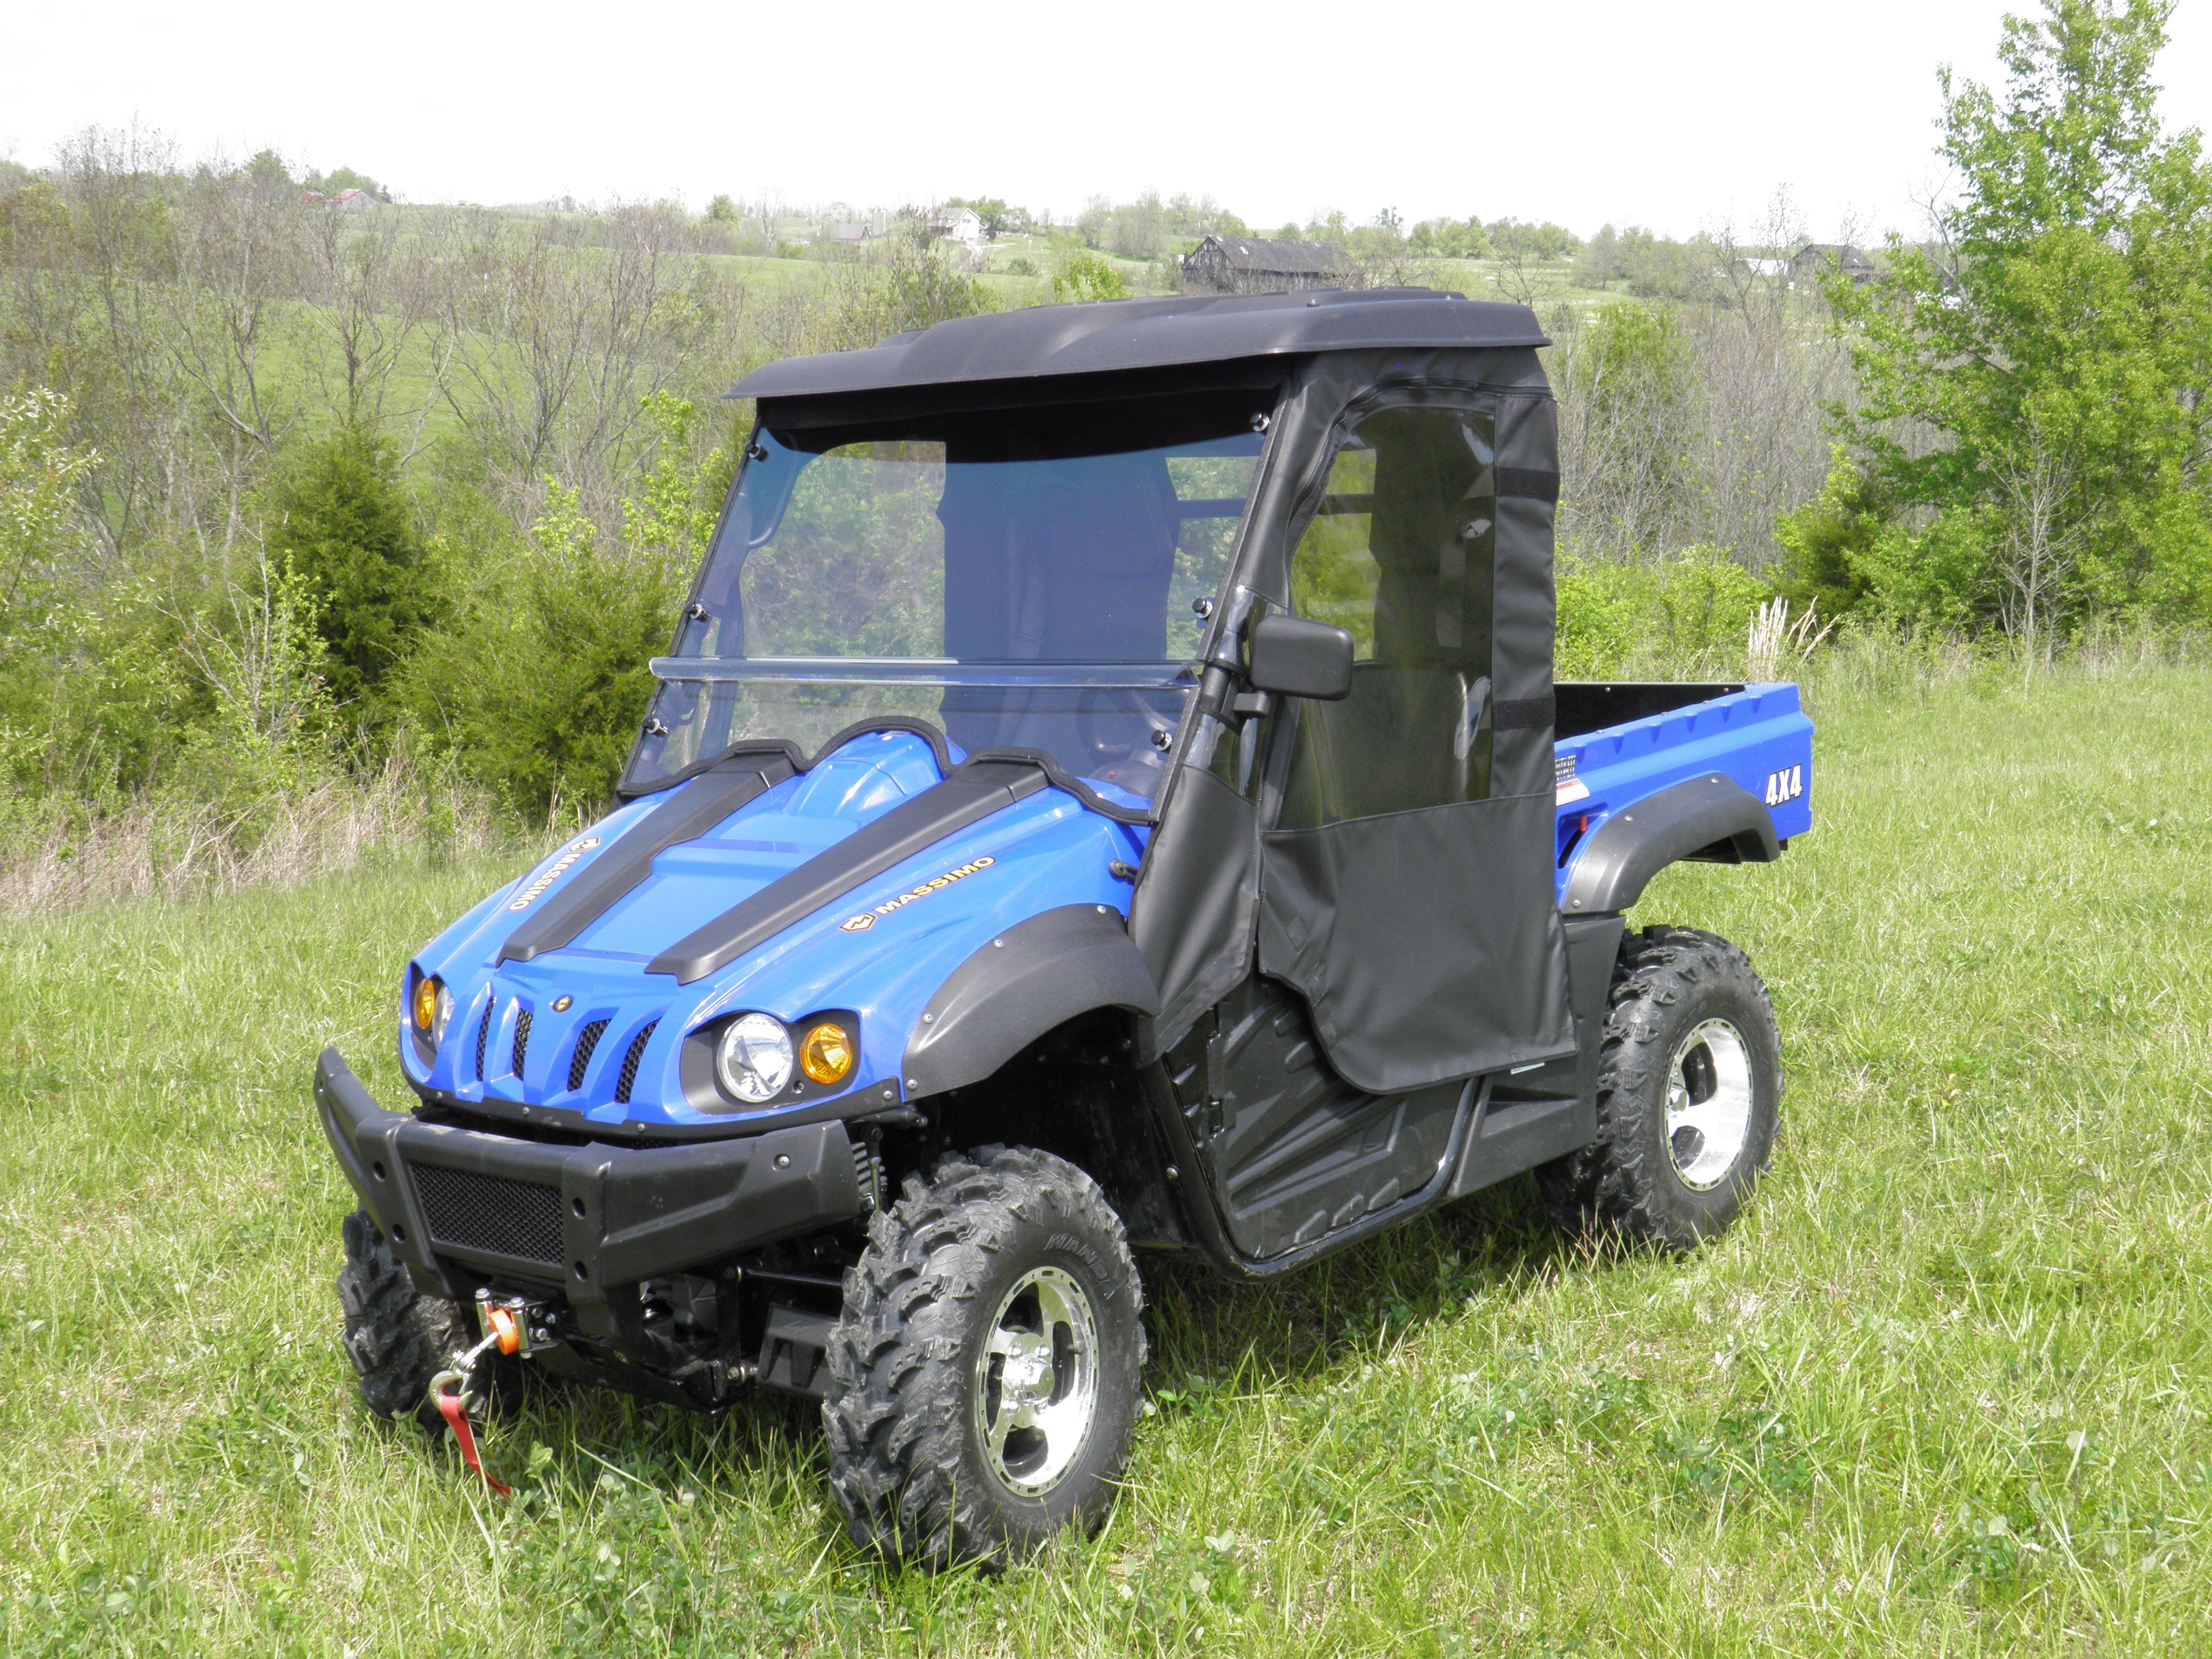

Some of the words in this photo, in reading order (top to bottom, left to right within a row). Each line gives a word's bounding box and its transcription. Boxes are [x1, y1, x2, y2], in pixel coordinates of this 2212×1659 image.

[1765, 763, 1802, 806] 4X4
[509, 853, 582, 911] MASSIMO
[873, 856, 996, 915] MASSIMO
